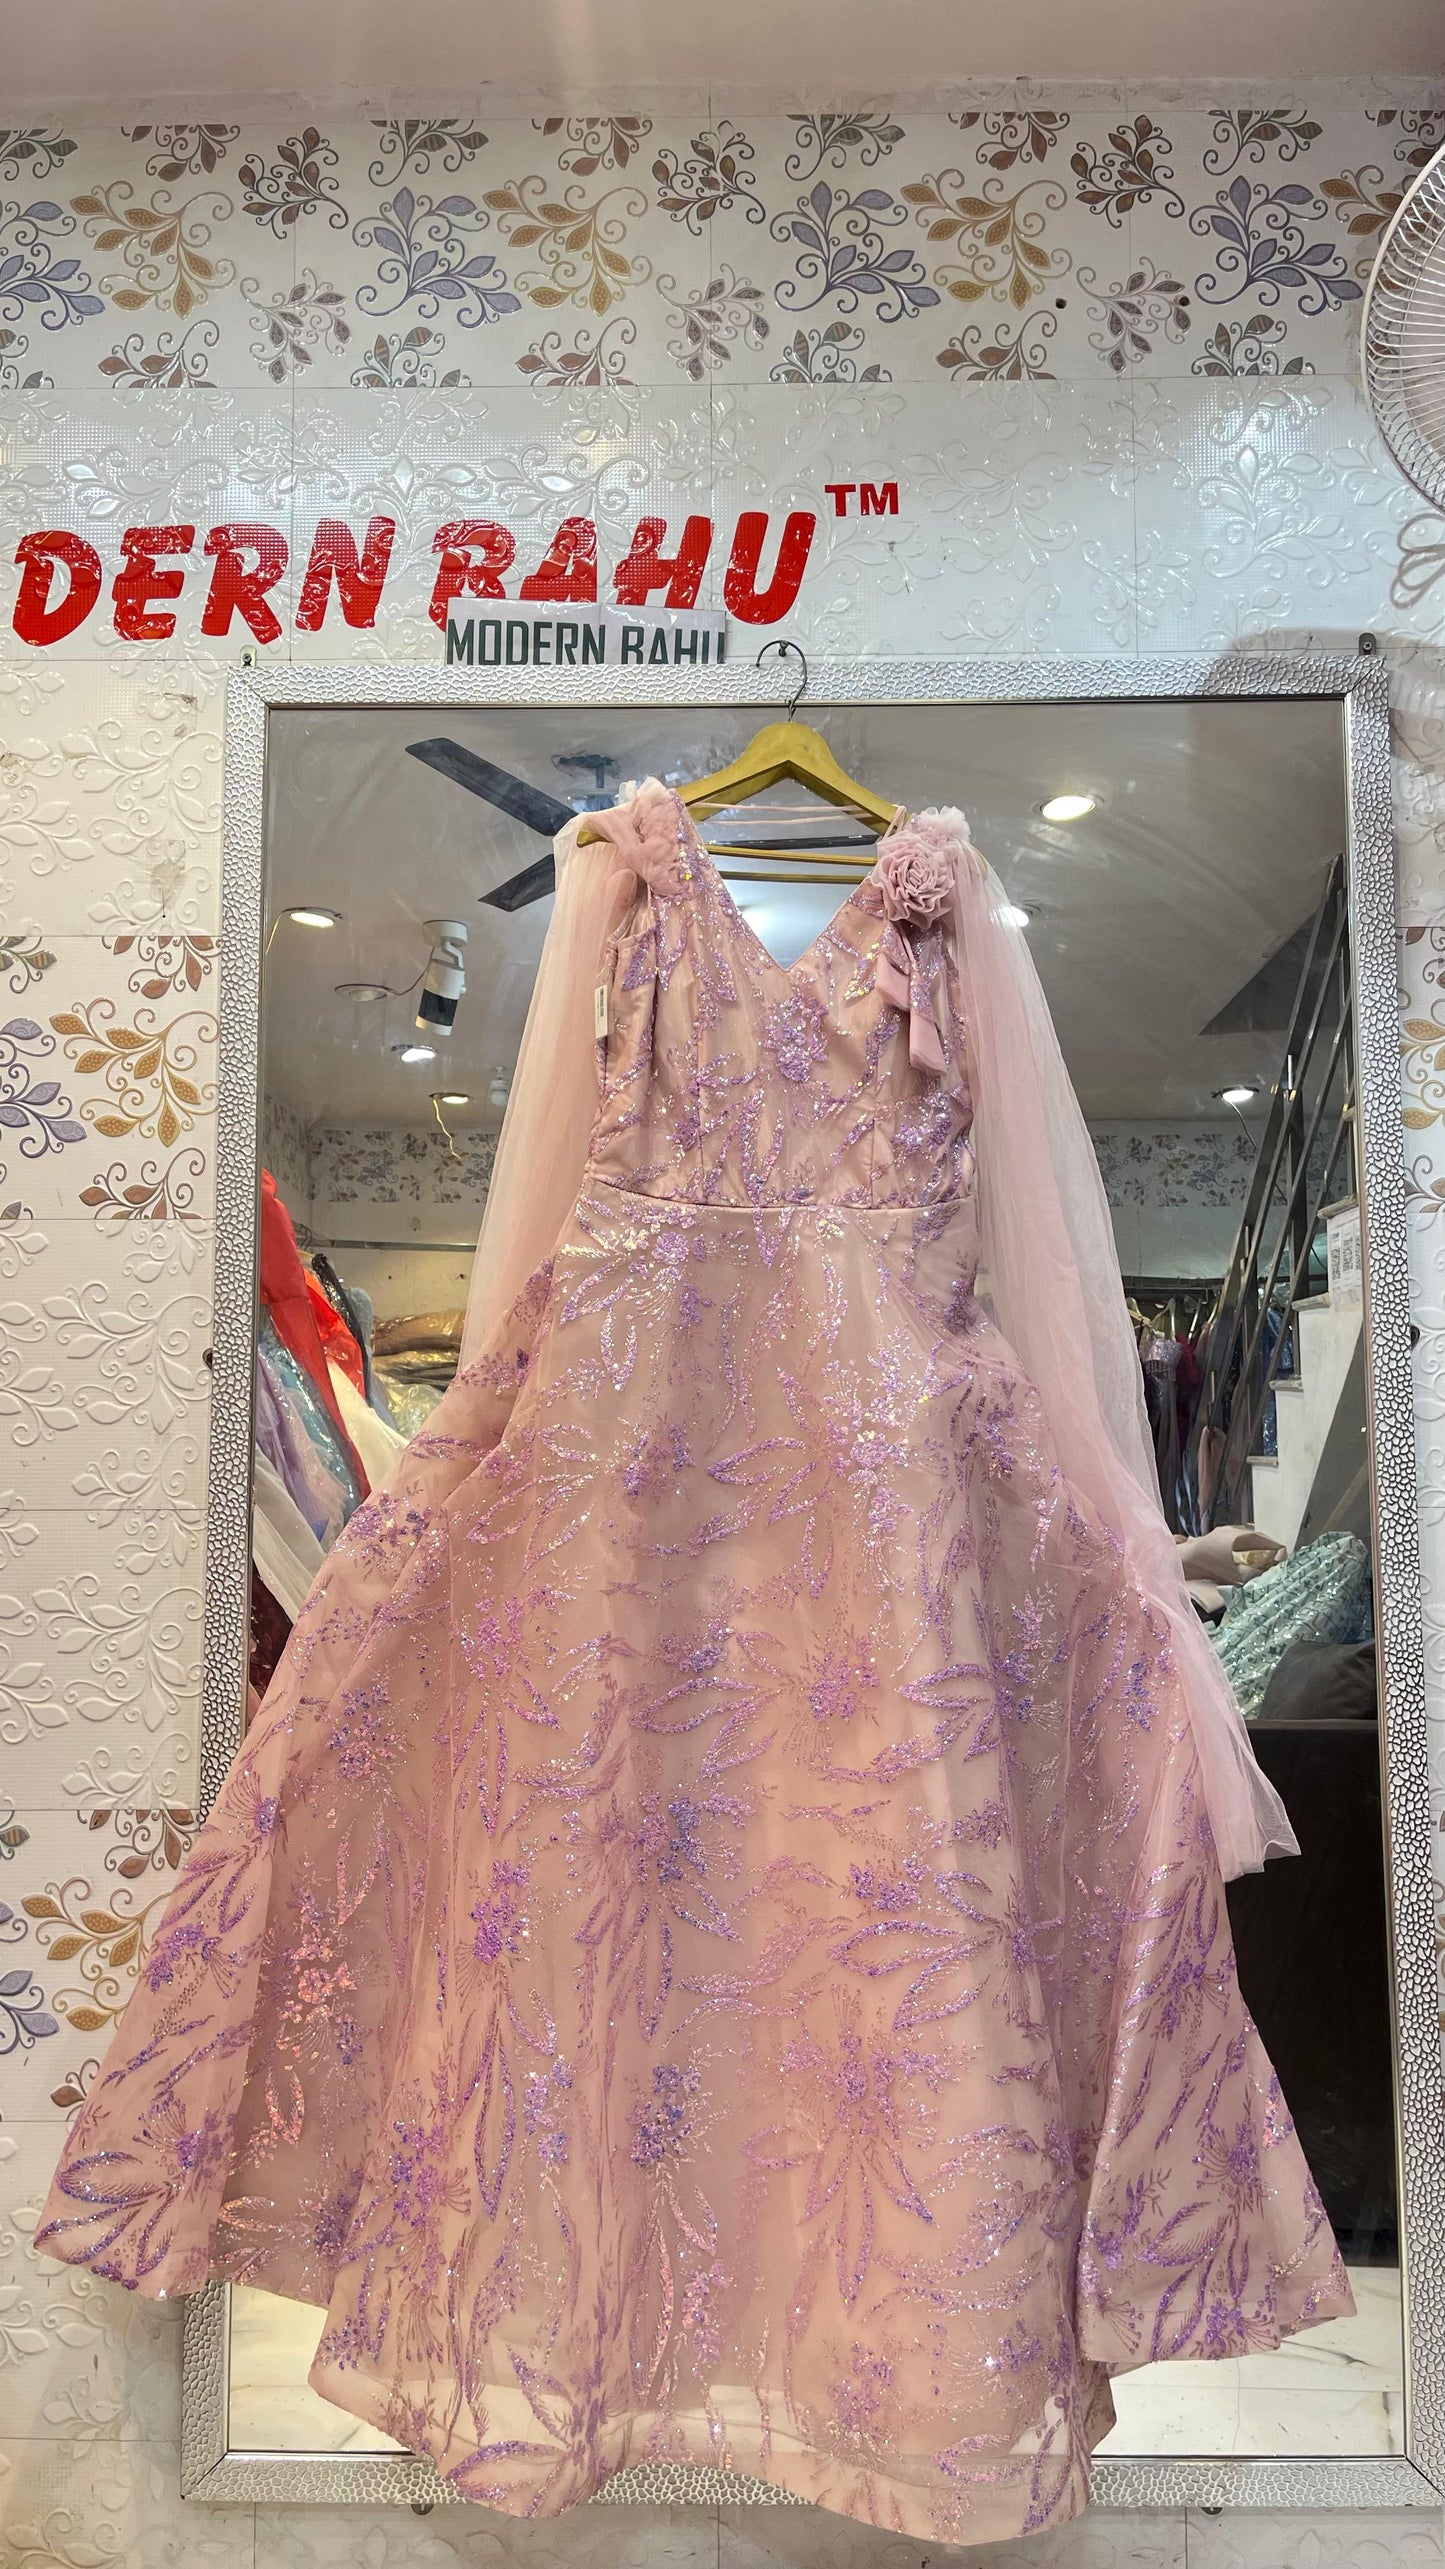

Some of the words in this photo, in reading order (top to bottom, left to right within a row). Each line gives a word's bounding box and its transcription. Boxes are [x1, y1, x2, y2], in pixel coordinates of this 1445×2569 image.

[12, 517, 396, 646] DERN
[427, 511, 817, 632] RAHU
[825, 482, 899, 517] TM
[447, 618, 606, 666] MODERN
